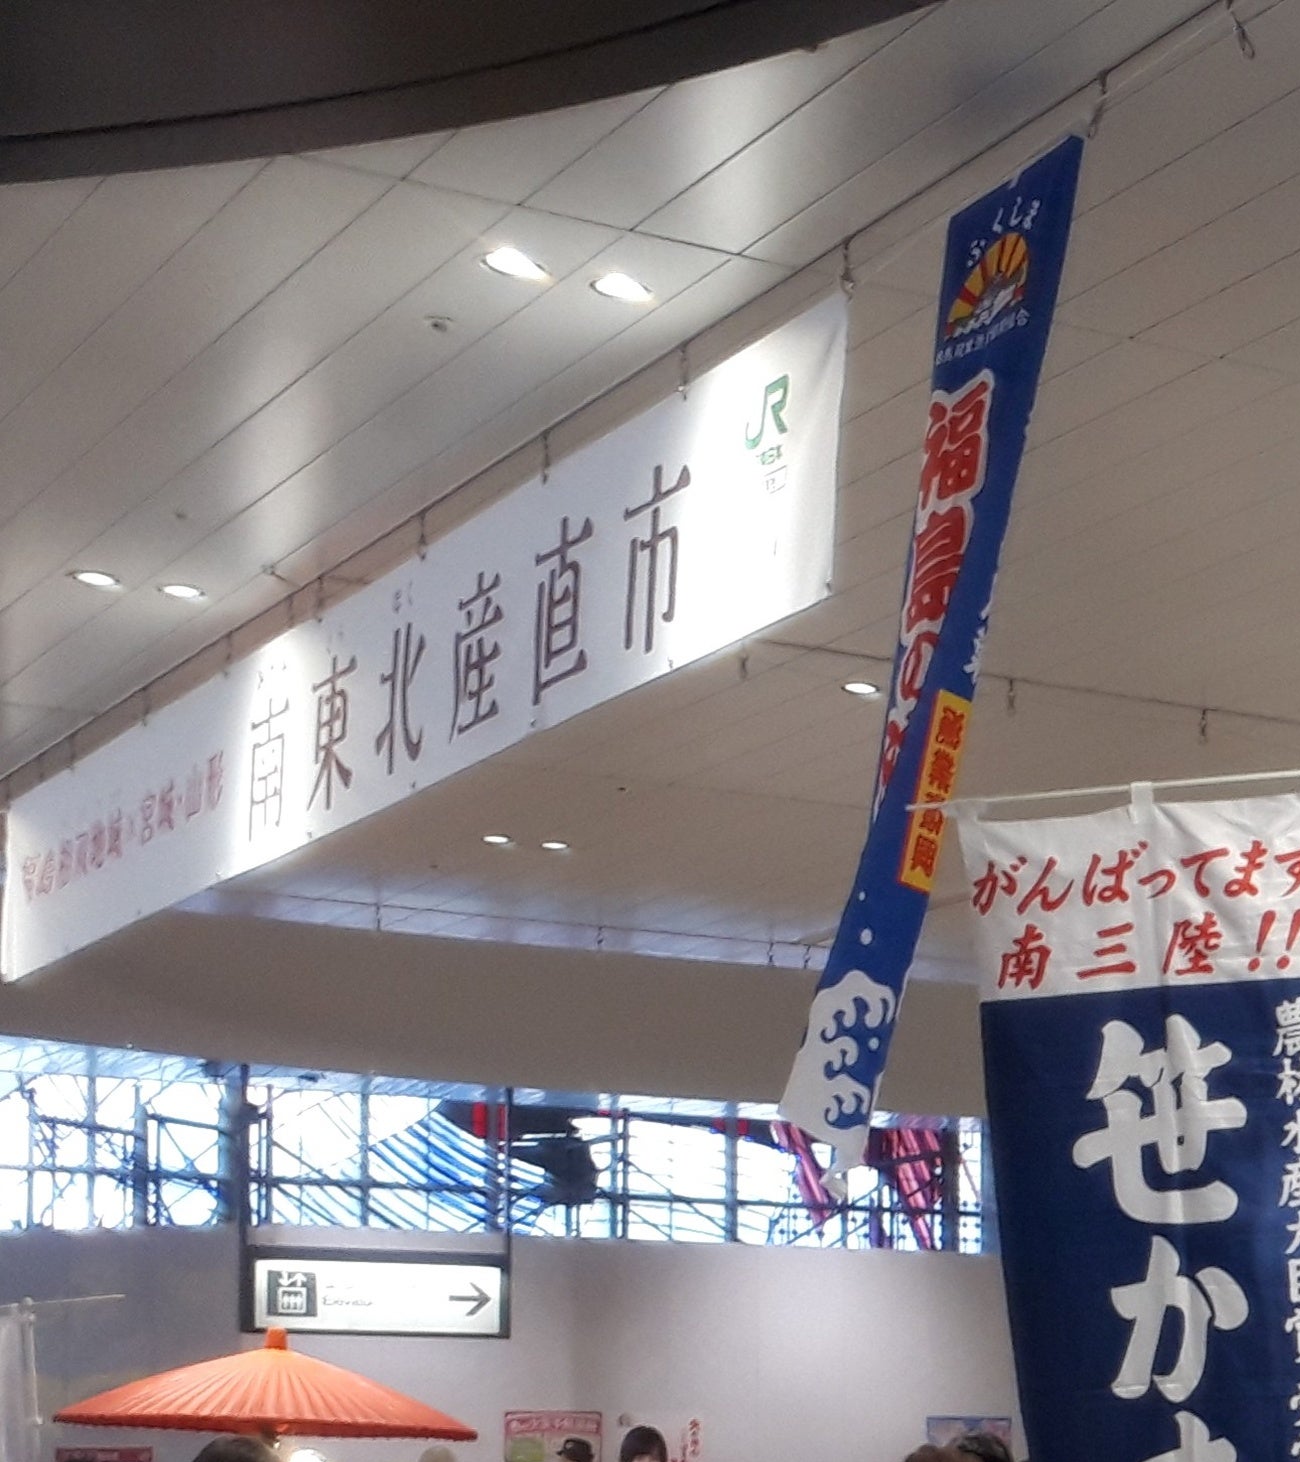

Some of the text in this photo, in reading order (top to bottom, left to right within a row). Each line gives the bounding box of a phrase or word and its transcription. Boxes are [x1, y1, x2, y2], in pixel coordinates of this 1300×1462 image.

[745, 374, 789, 450] JR
[248, 463, 690, 842] 南東北産直市
